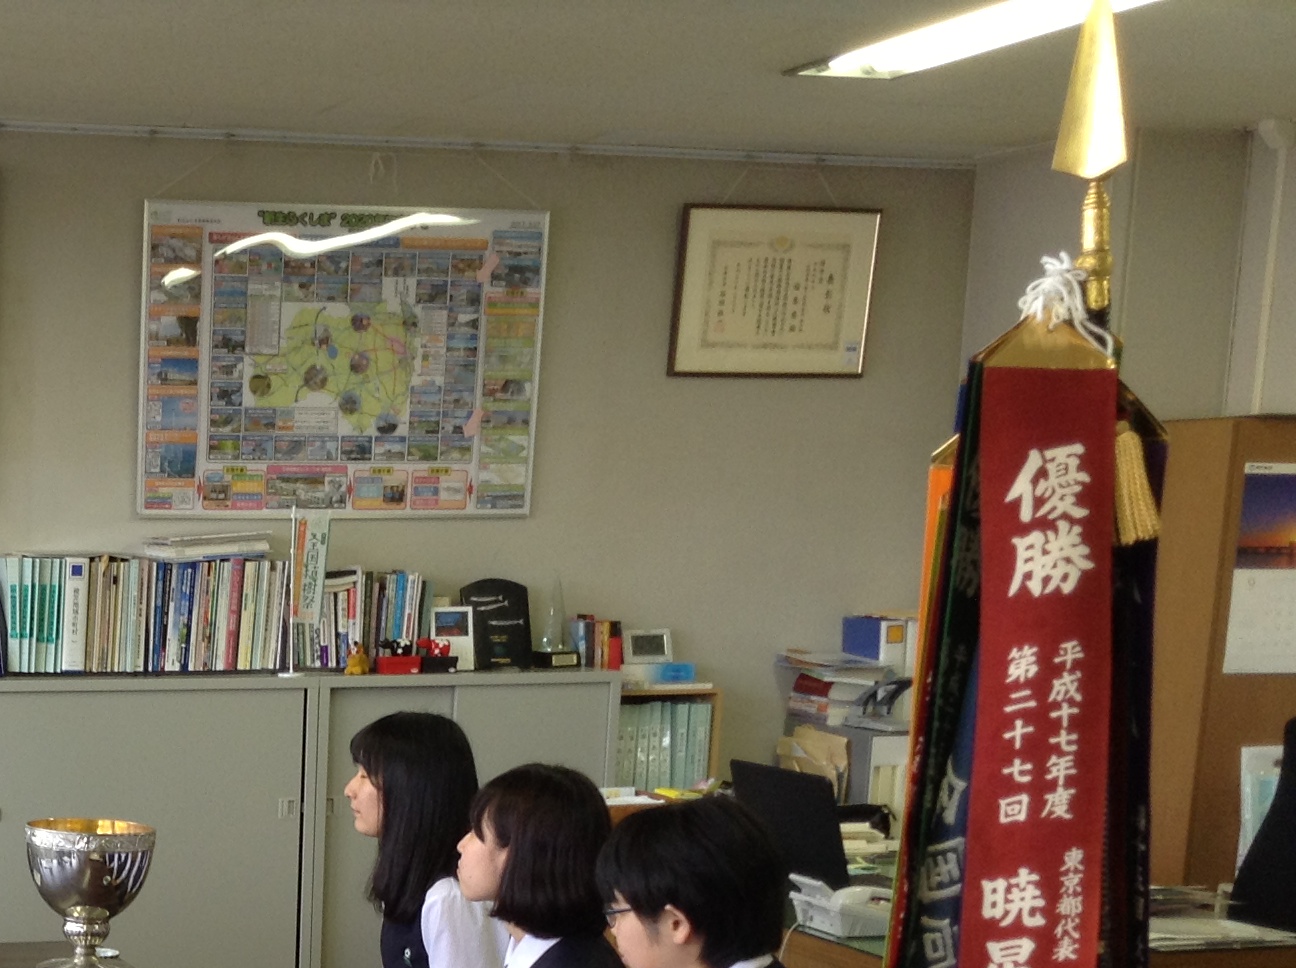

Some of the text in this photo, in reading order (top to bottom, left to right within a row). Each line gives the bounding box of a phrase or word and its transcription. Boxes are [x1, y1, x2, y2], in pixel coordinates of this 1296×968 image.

[1004, 442, 1095, 598] 優勝
[997, 644, 1040, 824] 第二十七回
[1040, 639, 1085, 820] 平成十七年度
[1051, 846, 1085, 962] 東京都代表
